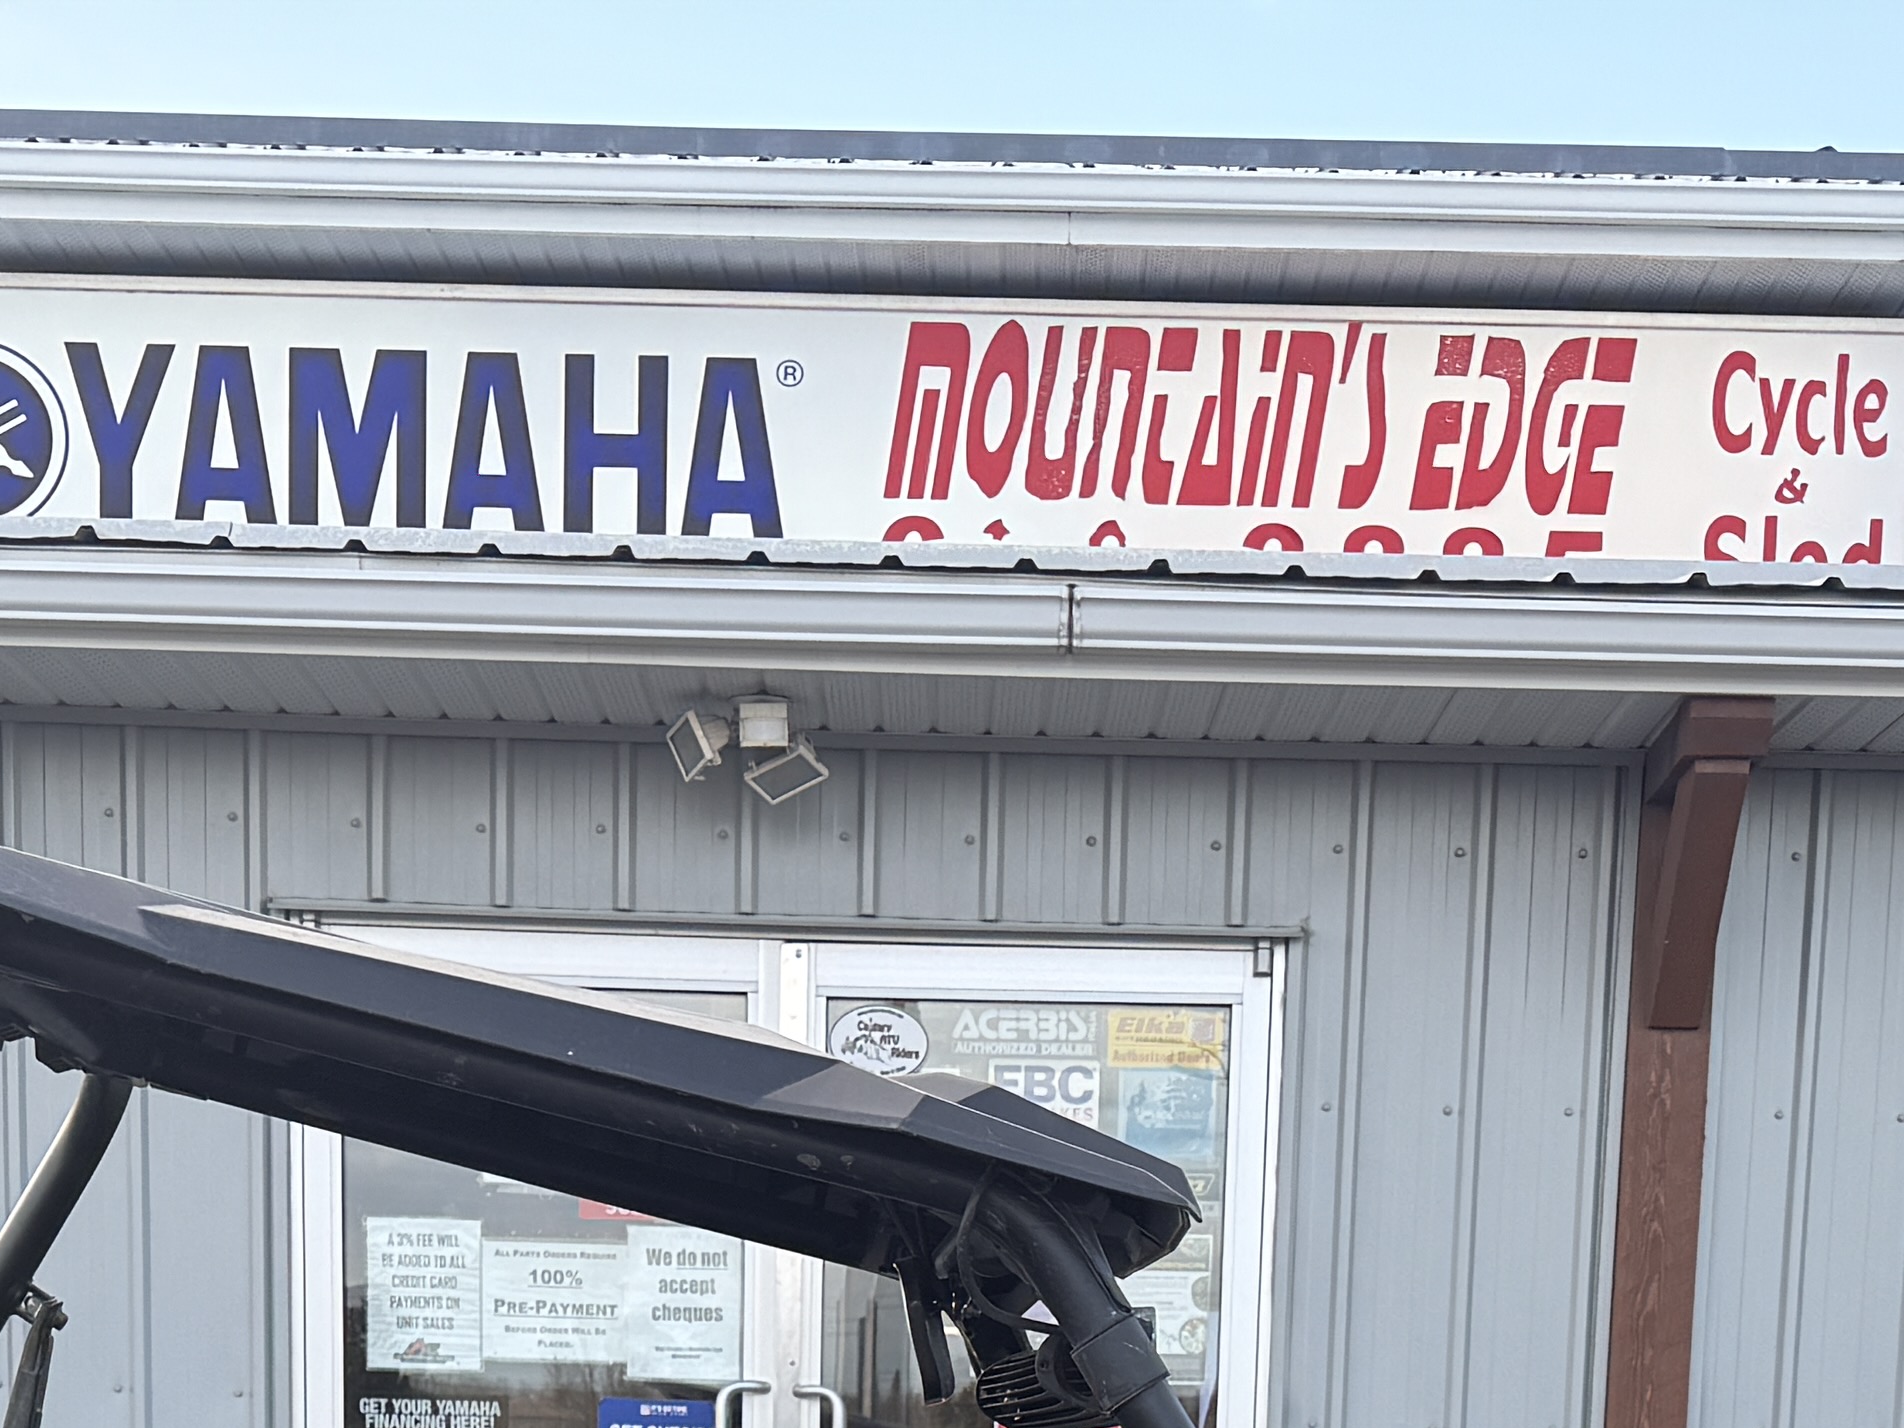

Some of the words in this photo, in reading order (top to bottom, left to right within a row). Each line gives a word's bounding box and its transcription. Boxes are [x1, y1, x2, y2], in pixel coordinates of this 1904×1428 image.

[1712, 350, 1889, 458] Cycle
[1409, 333, 1639, 516] EDGE
[64, 341, 784, 538] YAMAHA
[1774, 468, 1809, 504] &
[417, 1233, 434, 1247] FEE
[646, 1247, 672, 1266] We
[676, 1248, 697, 1267] do
[701, 1250, 728, 1267] not
[529, 1268, 583, 1286] 100%
[658, 1278, 716, 1296] accept
[651, 1303, 724, 1324] cheques
[359, 1397, 389, 1414] GET
[392, 1398, 432, 1416] YOUR
[436, 1399, 501, 1417] YAMAHA
